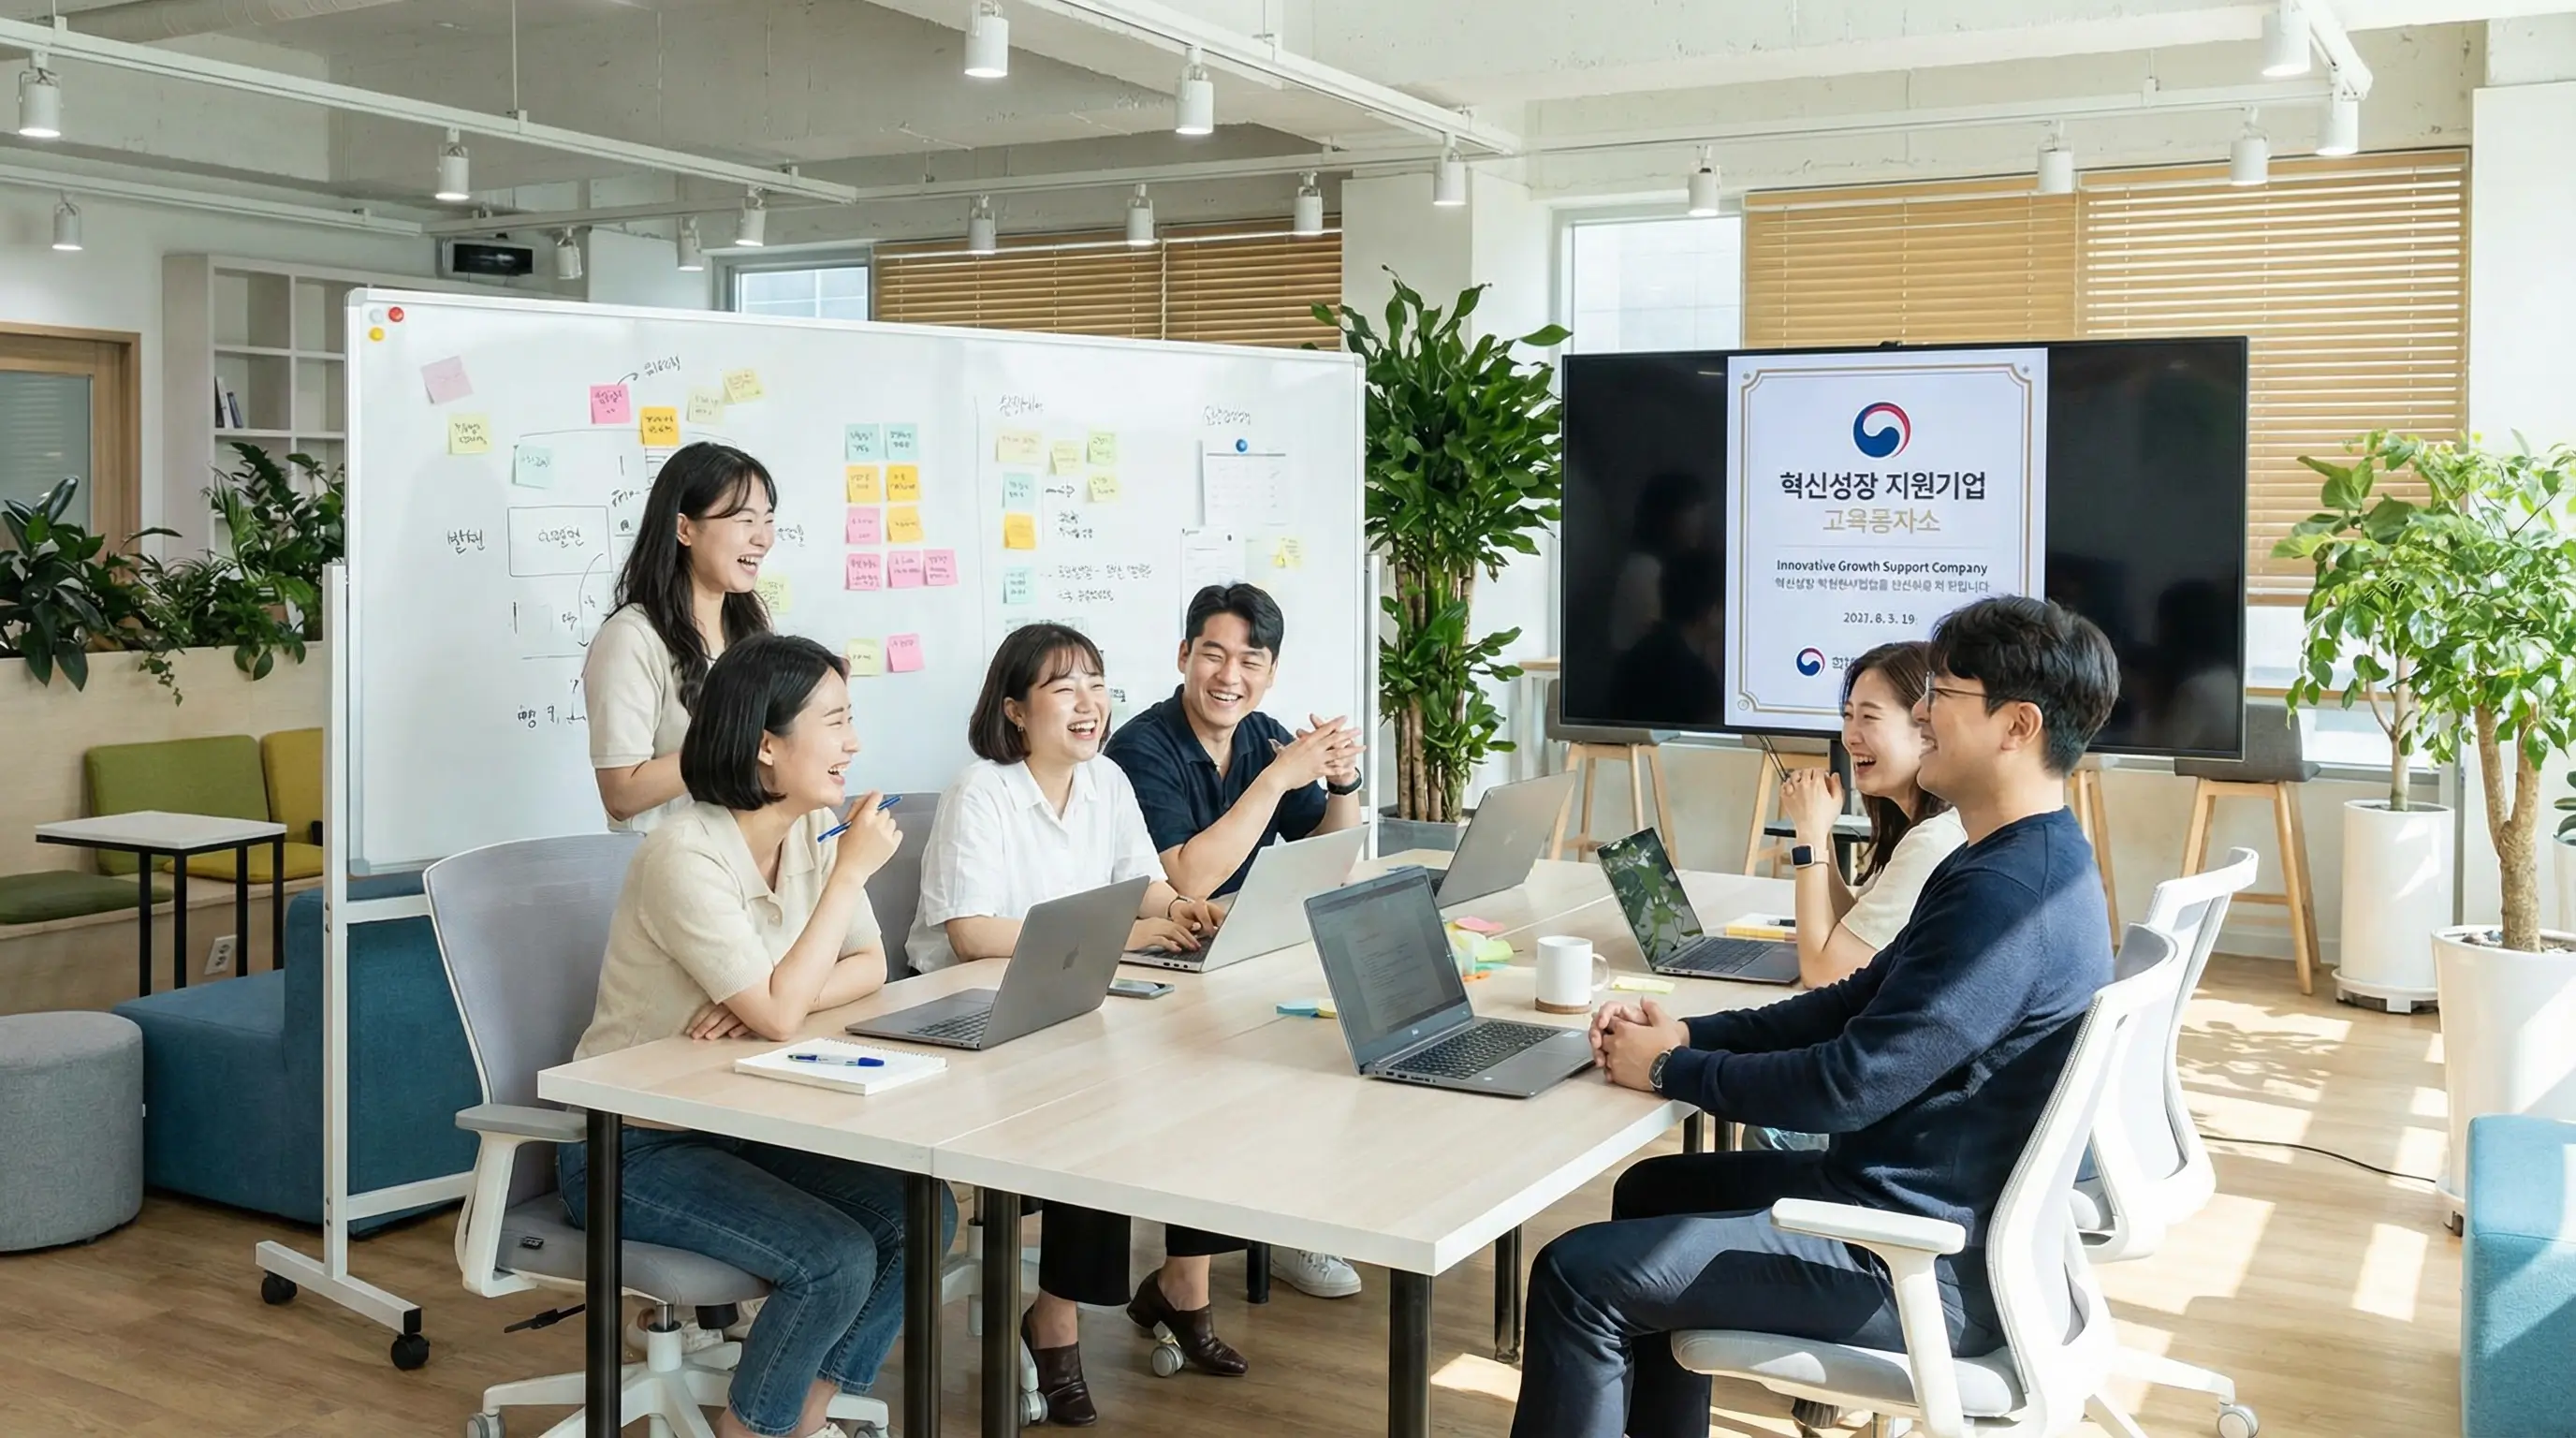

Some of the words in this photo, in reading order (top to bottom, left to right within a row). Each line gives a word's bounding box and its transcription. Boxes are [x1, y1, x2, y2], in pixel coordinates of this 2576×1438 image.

[1779, 471, 1879, 501] 혁신성장
[1885, 471, 1986, 501] 지원기업
[1777, 559, 1836, 571] Innovative
[1837, 560, 1881, 572] Growth
[1882, 561, 1929, 575] Support
[1932, 562, 1988, 577] Company
